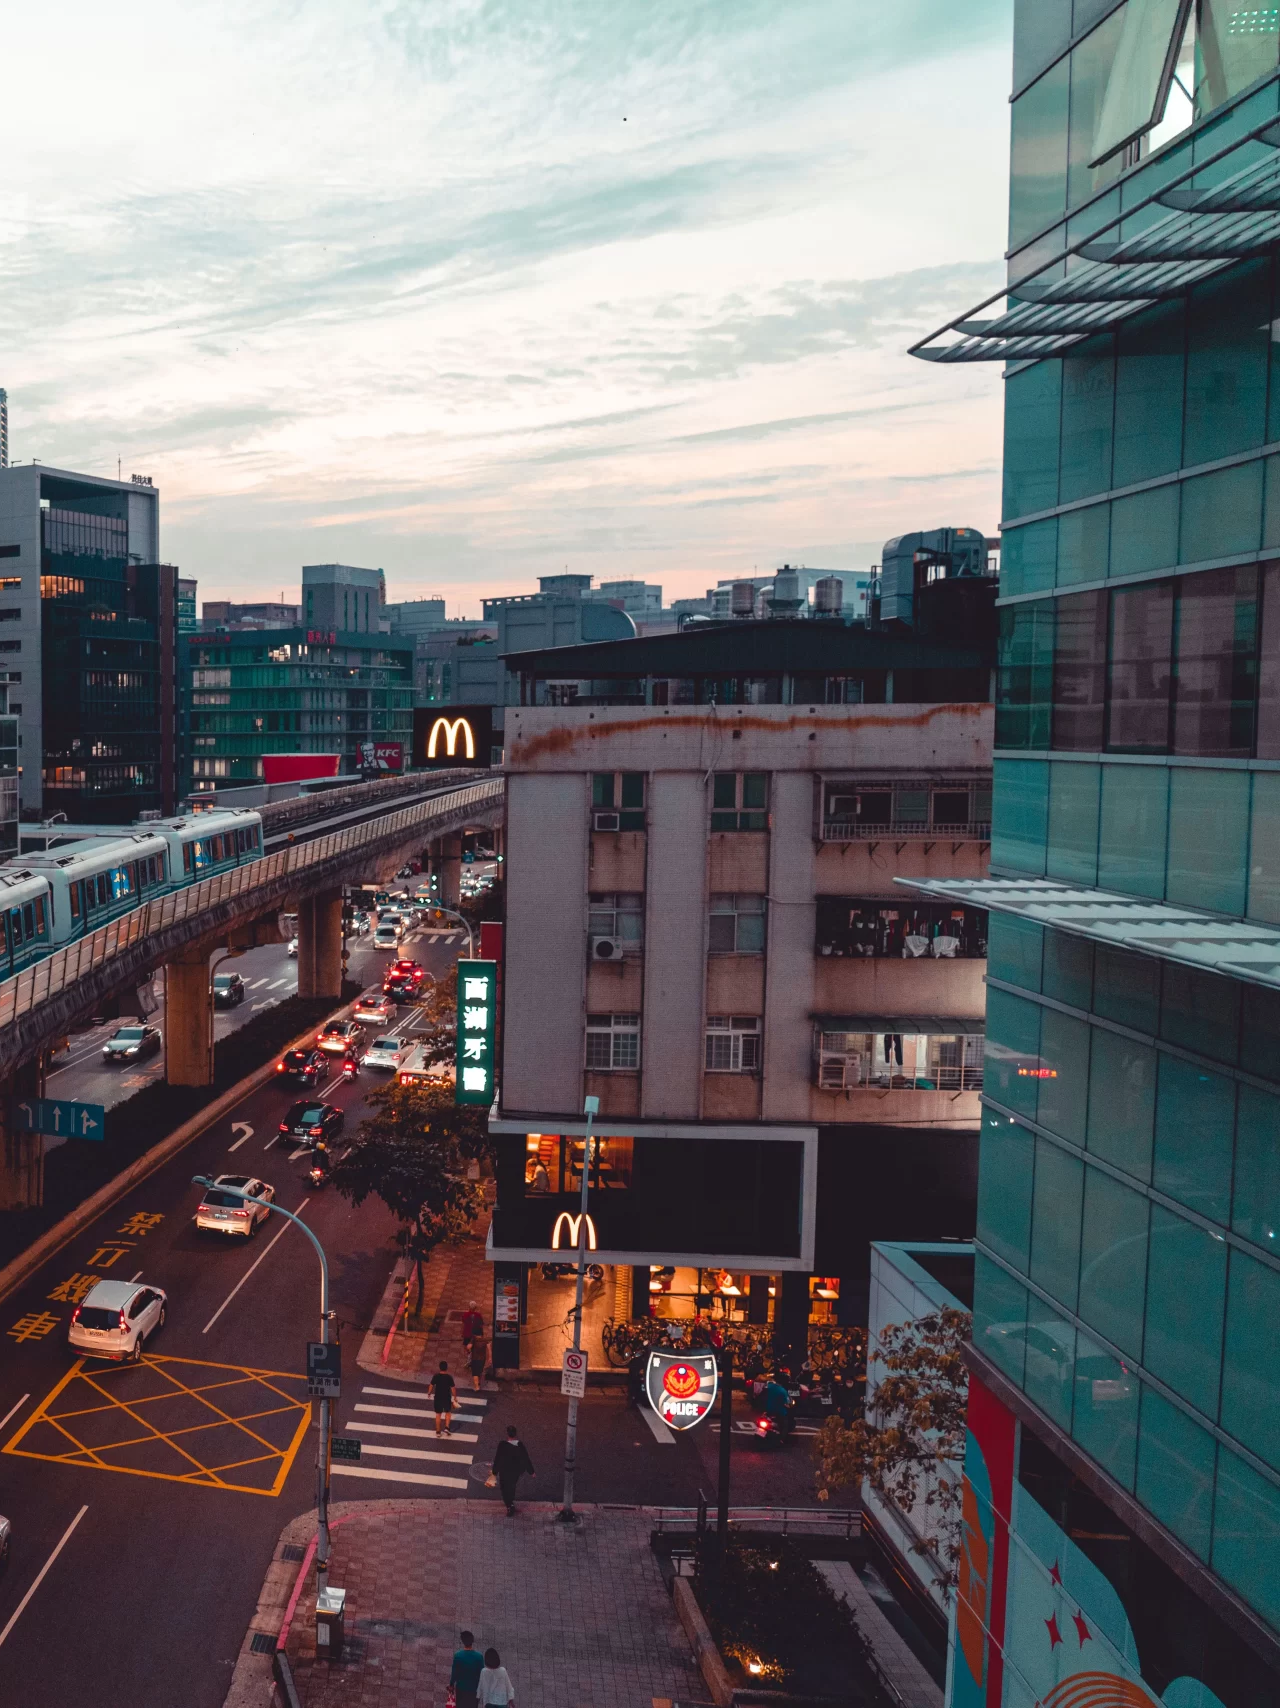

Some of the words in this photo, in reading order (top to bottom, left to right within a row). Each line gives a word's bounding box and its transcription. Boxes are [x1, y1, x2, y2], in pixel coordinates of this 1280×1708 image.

[376, 749, 400, 758] KFC
[309, 1343, 328, 1368] P
[663, 1402, 699, 1416] POLICE
